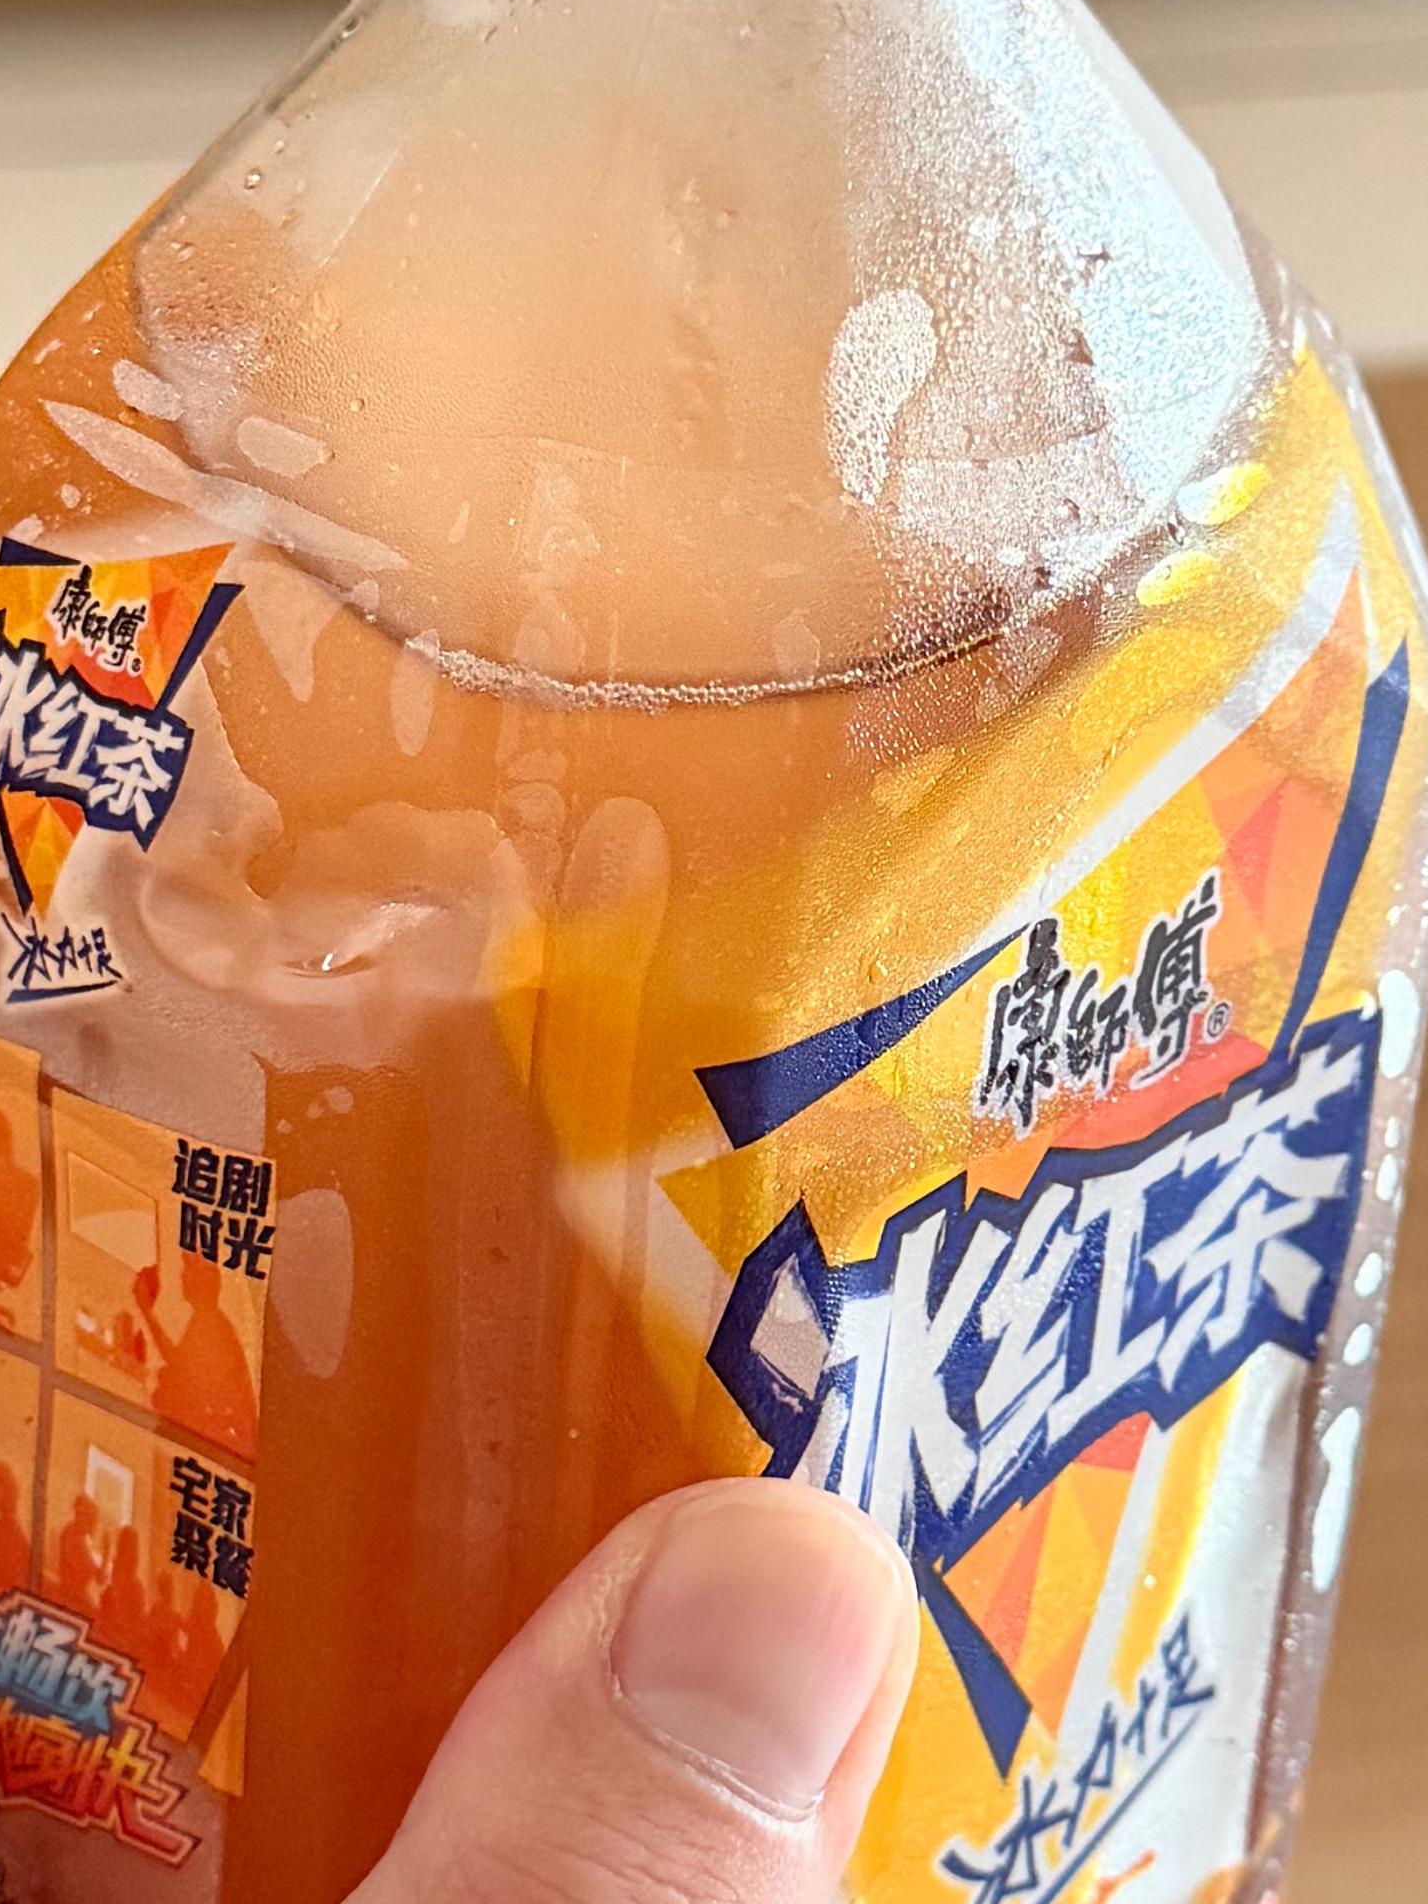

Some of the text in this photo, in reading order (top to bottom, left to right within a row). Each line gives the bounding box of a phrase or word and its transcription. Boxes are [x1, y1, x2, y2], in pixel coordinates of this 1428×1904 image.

[52, 564, 146, 666] 康師傅
[979, 875, 1217, 1128] 康師傅
[171, 1138, 272, 1217] 追剧
[179, 1201, 276, 1280] 时光
[748, 1041, 1364, 1578] 冰红茶
[169, 1456, 252, 1541] 宅家
